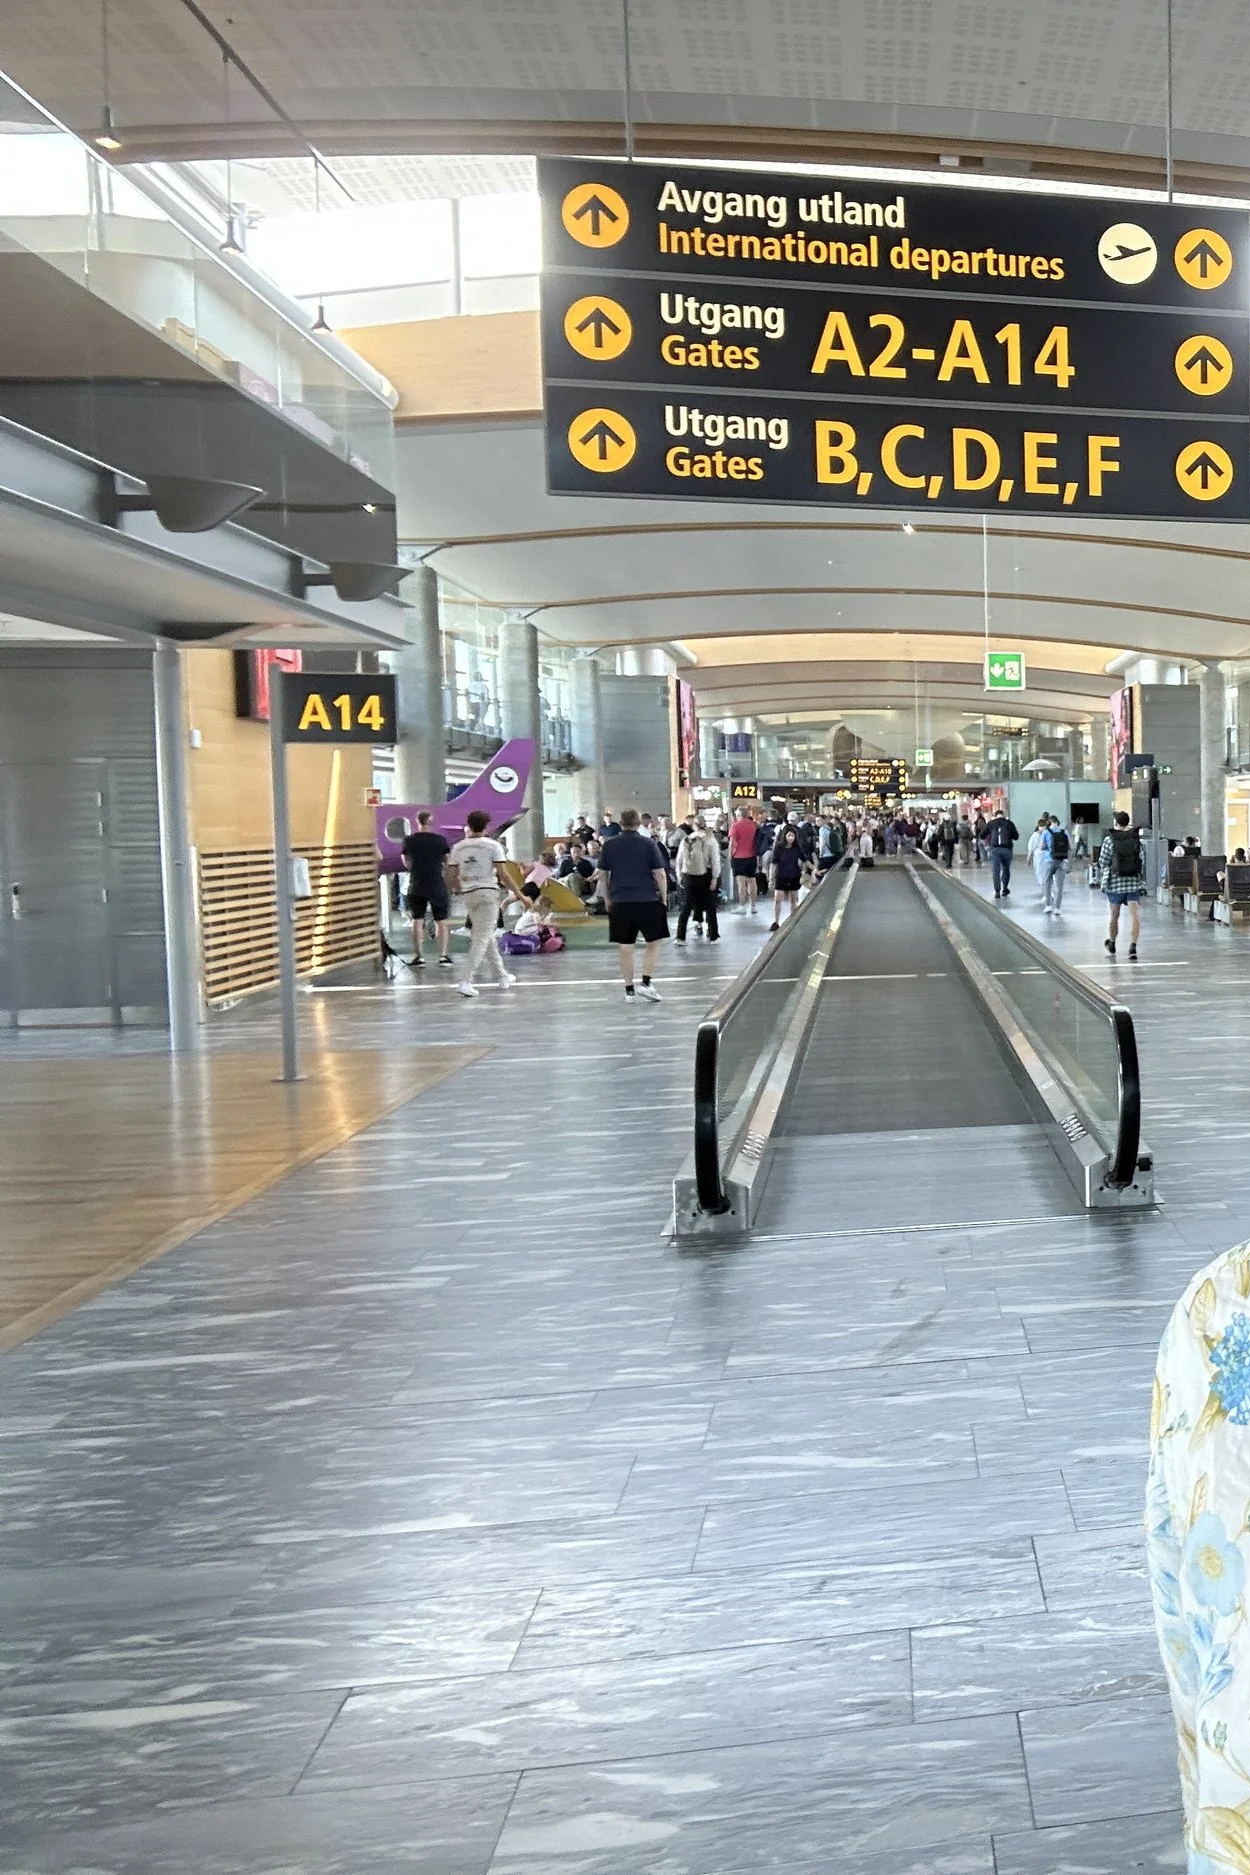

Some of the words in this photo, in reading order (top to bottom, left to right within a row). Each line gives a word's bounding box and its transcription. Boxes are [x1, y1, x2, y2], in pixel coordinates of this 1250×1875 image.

[657, 180, 788, 228] Avgang
[798, 191, 906, 227] utland
[659, 222, 879, 268] International
[889, 235, 1065, 281] departures
[660, 292, 785, 339] Utgang
[661, 334, 760, 370] Gates
[810, 311, 1076, 389] A2-A14
[664, 405, 789, 450] Utgang
[666, 446, 764, 481] Gates
[815, 420, 1121, 505] B,C,D,E,F
[298, 693, 385, 731] A14
[734, 786, 756, 797] A12
